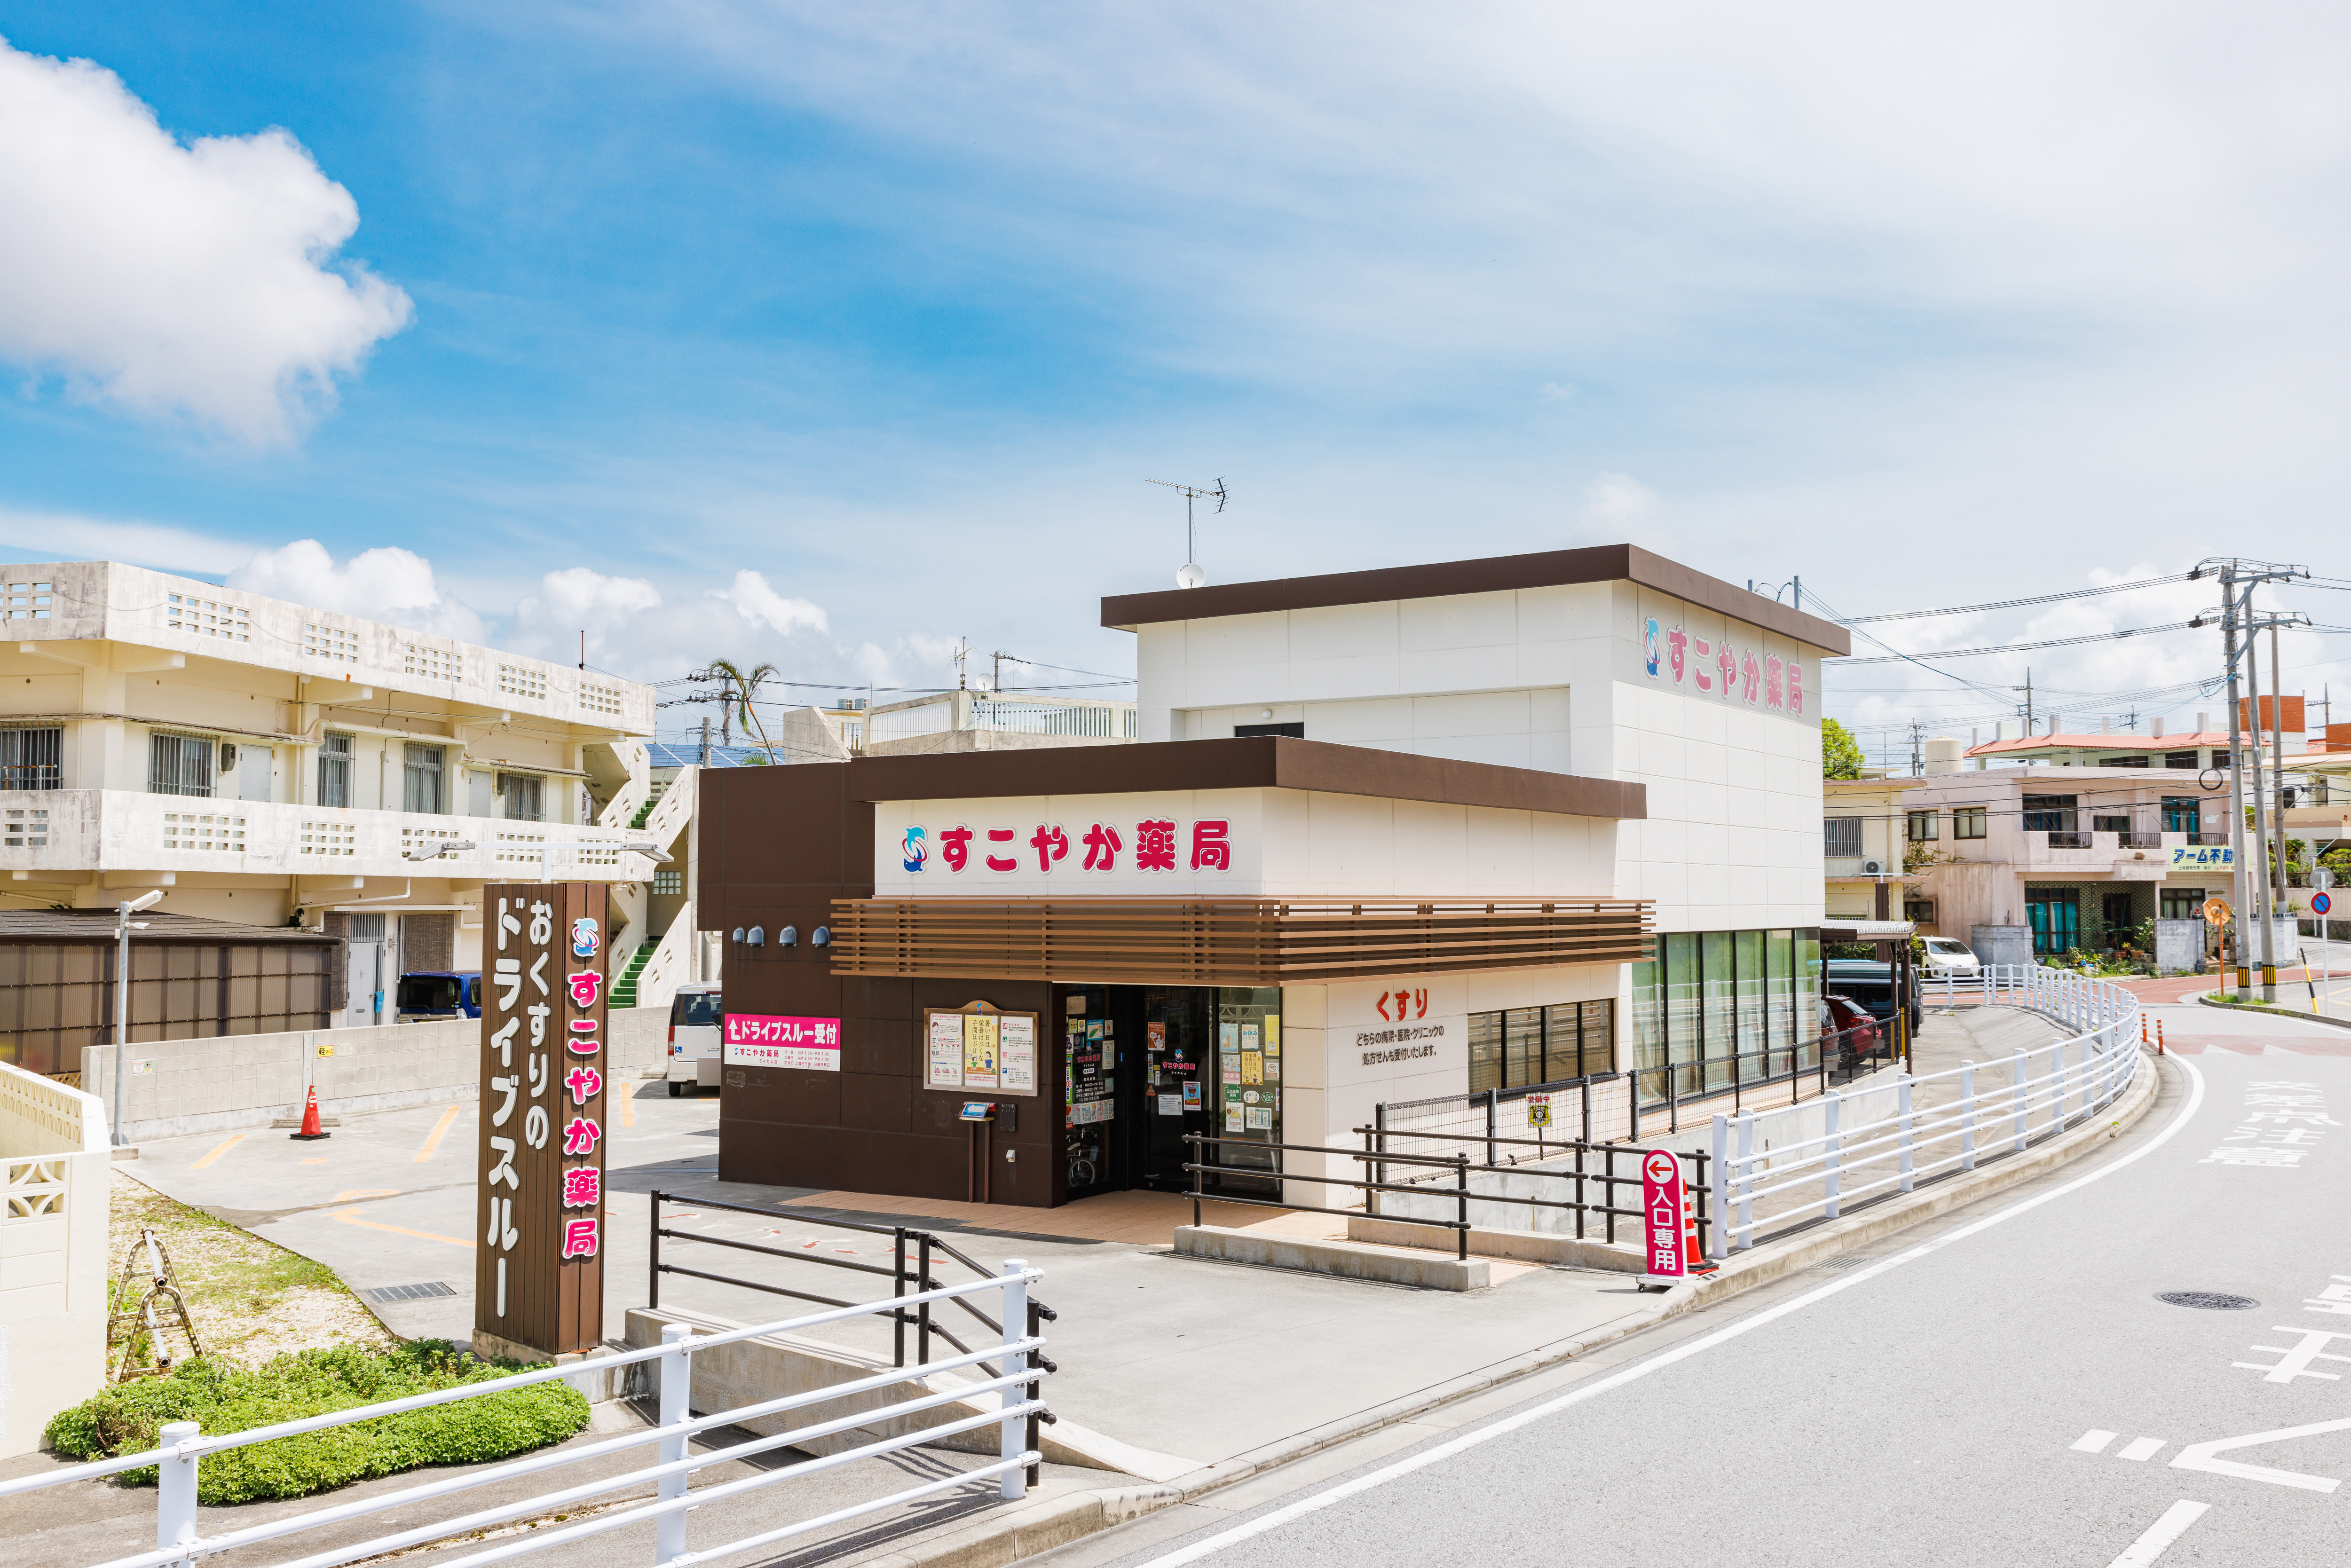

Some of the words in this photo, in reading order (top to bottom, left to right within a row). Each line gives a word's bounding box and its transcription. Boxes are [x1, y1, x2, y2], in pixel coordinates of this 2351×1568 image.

[1667, 625, 1803, 717] すこやか薬局
[939, 817, 1233, 875] すこやか薬局
[2173, 849, 2233, 864] アーム不動
[525, 900, 553, 1150] おくすりの
[1376, 988, 1428, 1022] くすり
[740, 1048, 779, 1057] すこやか薬局
[742, 1020, 837, 1045] ドライブスルー受付
[1356, 1025, 1444, 1047] どちらの病院・医院・クリニックの
[1362, 1044, 1437, 1066] 処方せんも受付いたします。
[1077, 1054, 1101, 1063] すこやか薬局
[488, 897, 526, 1317] ドライブスルー
[562, 969, 603, 1259] すこやか薬局
[2197, 1080, 2345, 1168] 交差点注意
[1651, 1186, 1676, 1271] 入口専用
